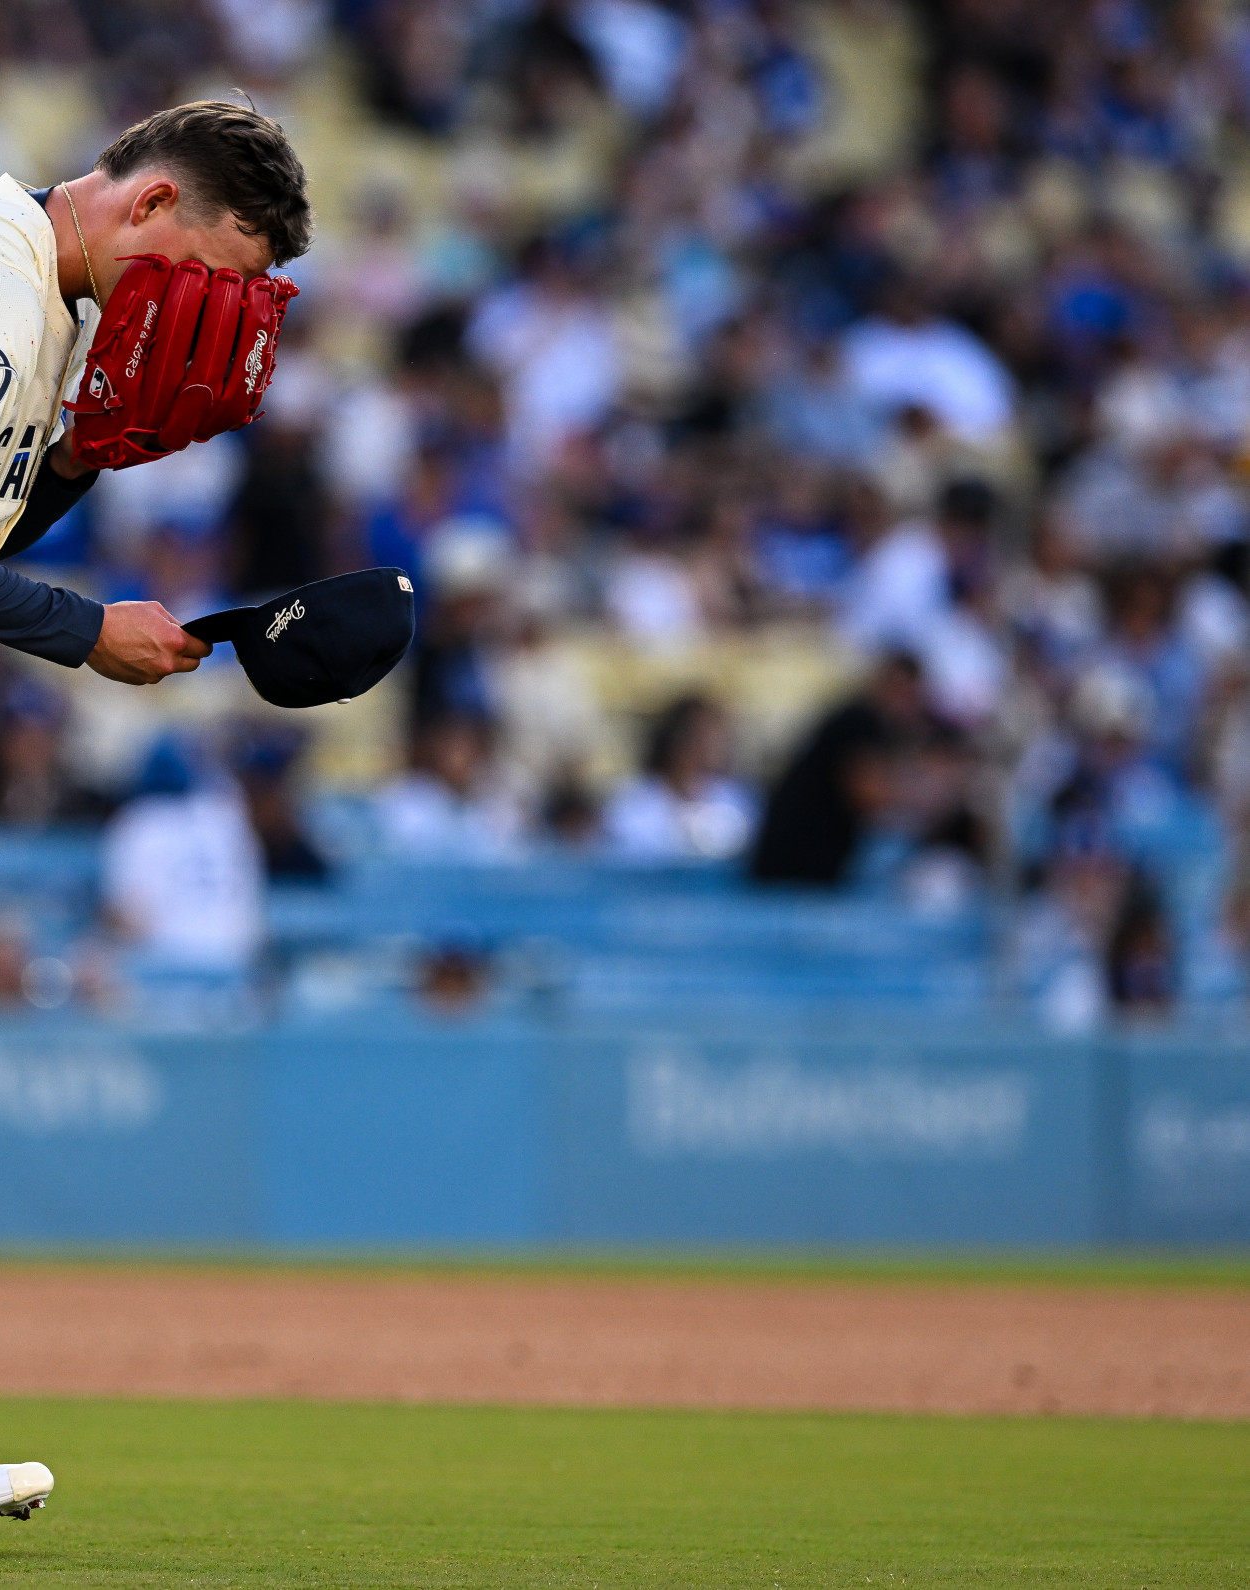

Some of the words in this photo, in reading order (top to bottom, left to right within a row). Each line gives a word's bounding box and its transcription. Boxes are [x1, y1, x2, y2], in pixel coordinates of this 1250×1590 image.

[125, 341, 145, 378] LORD
[244, 329, 268, 395] Rawlings
[265, 599, 305, 642] Dodgers
